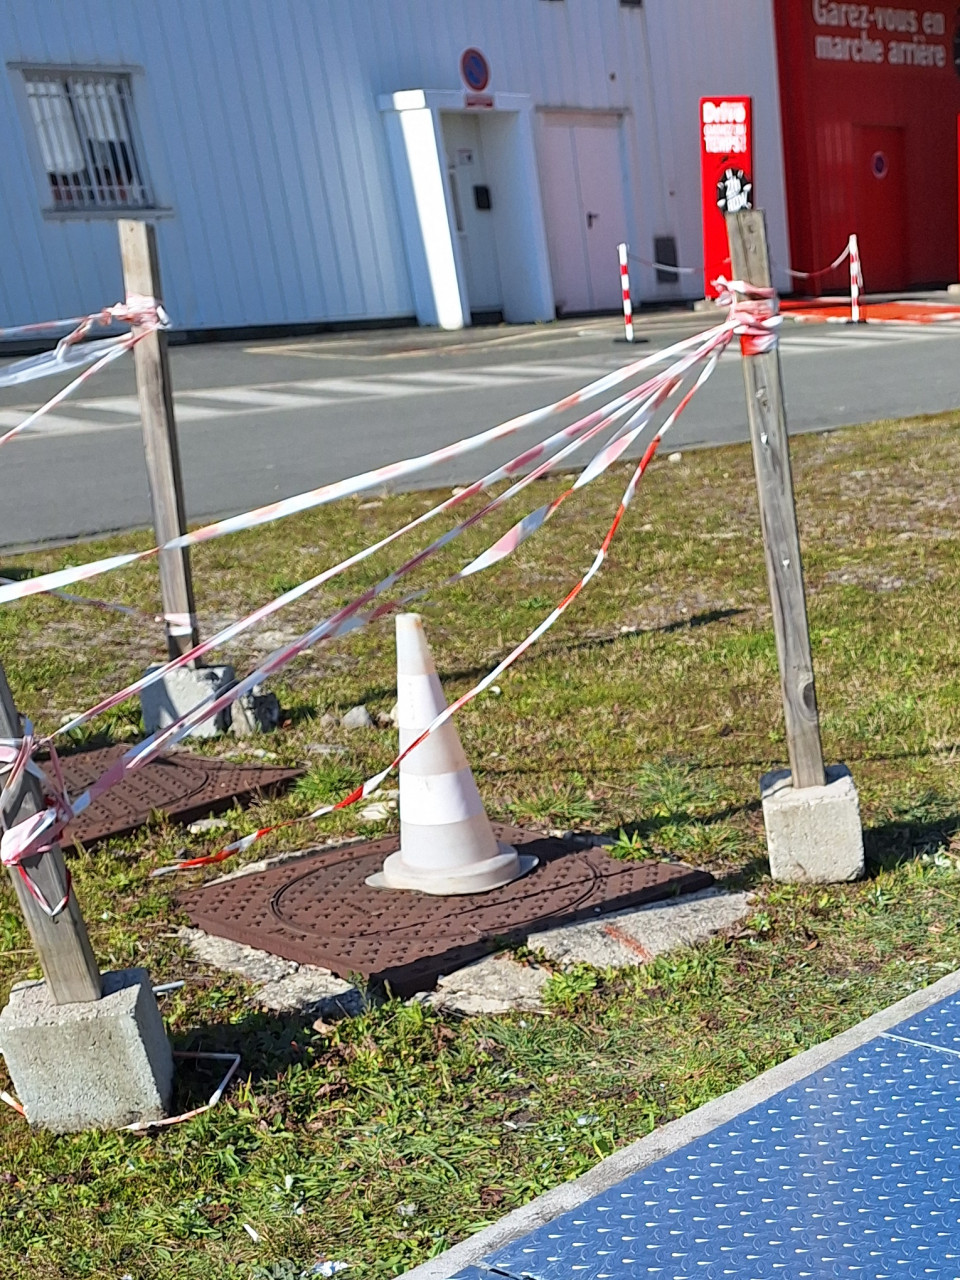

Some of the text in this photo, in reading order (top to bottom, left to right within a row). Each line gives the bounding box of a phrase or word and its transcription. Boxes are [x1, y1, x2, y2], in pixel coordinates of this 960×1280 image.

[812, 0, 946, 36] Garez-vous en
[815, 29, 884, 63] marche
[887, 34, 947, 68] arrière
